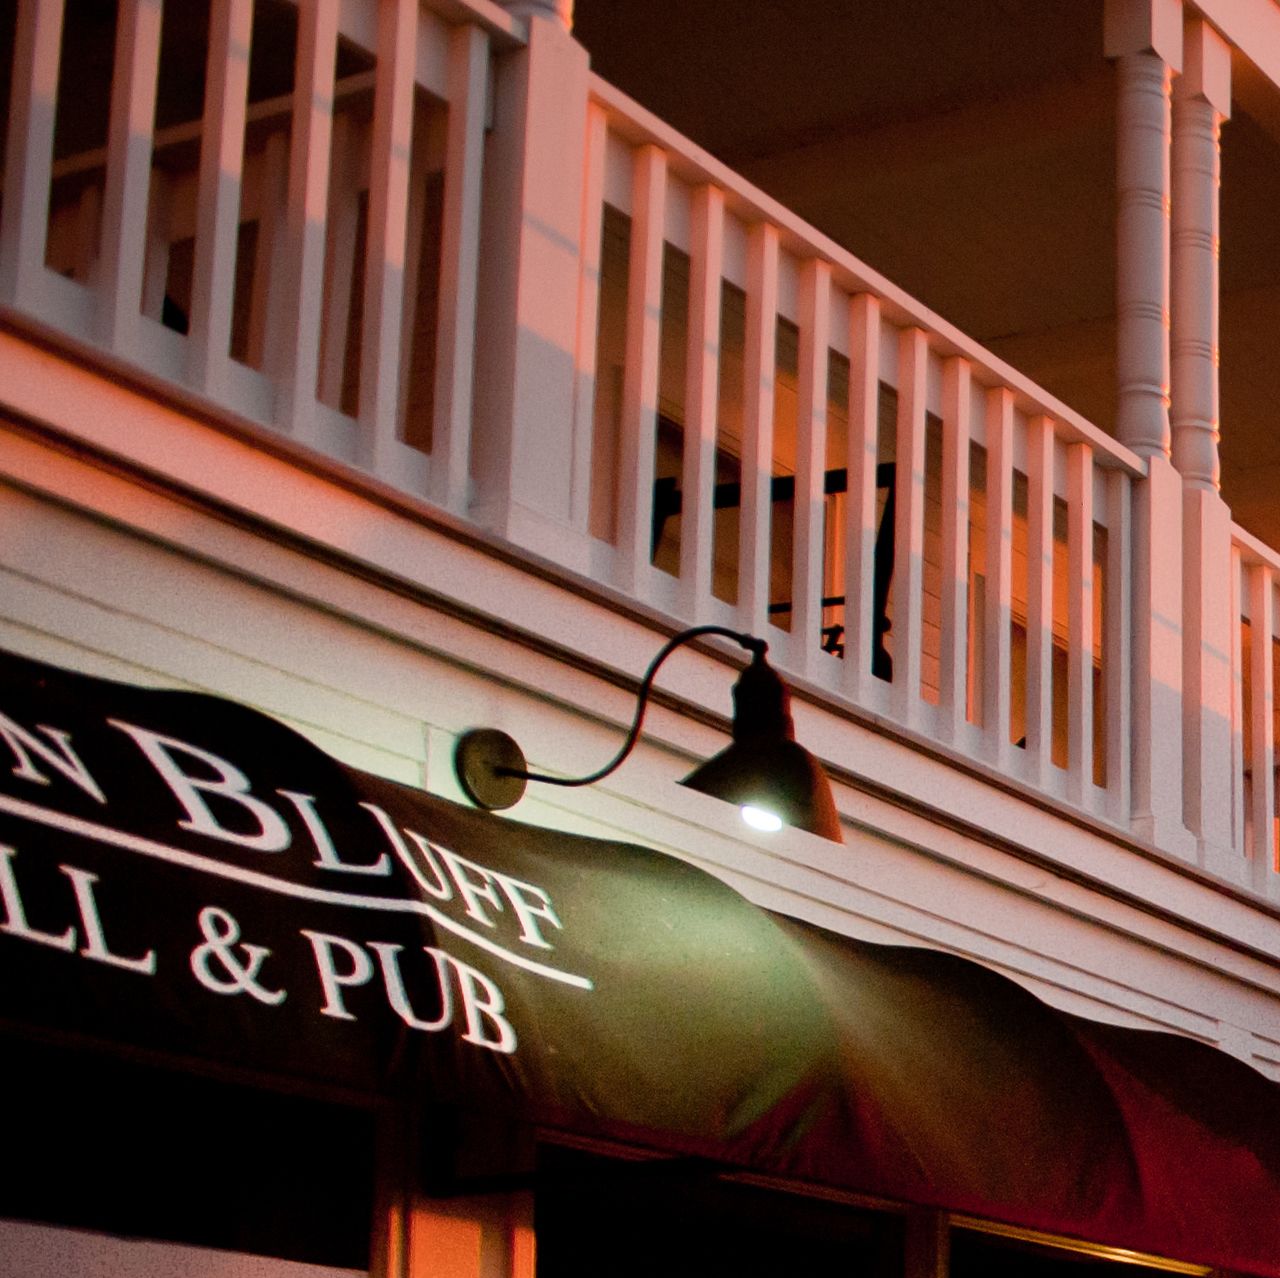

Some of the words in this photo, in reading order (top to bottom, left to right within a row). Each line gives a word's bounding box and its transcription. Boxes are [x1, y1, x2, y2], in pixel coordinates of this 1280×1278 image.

[106, 717, 563, 950] BLUFF
[190, 906, 287, 1005] &
[300, 929, 518, 1055] PUB
